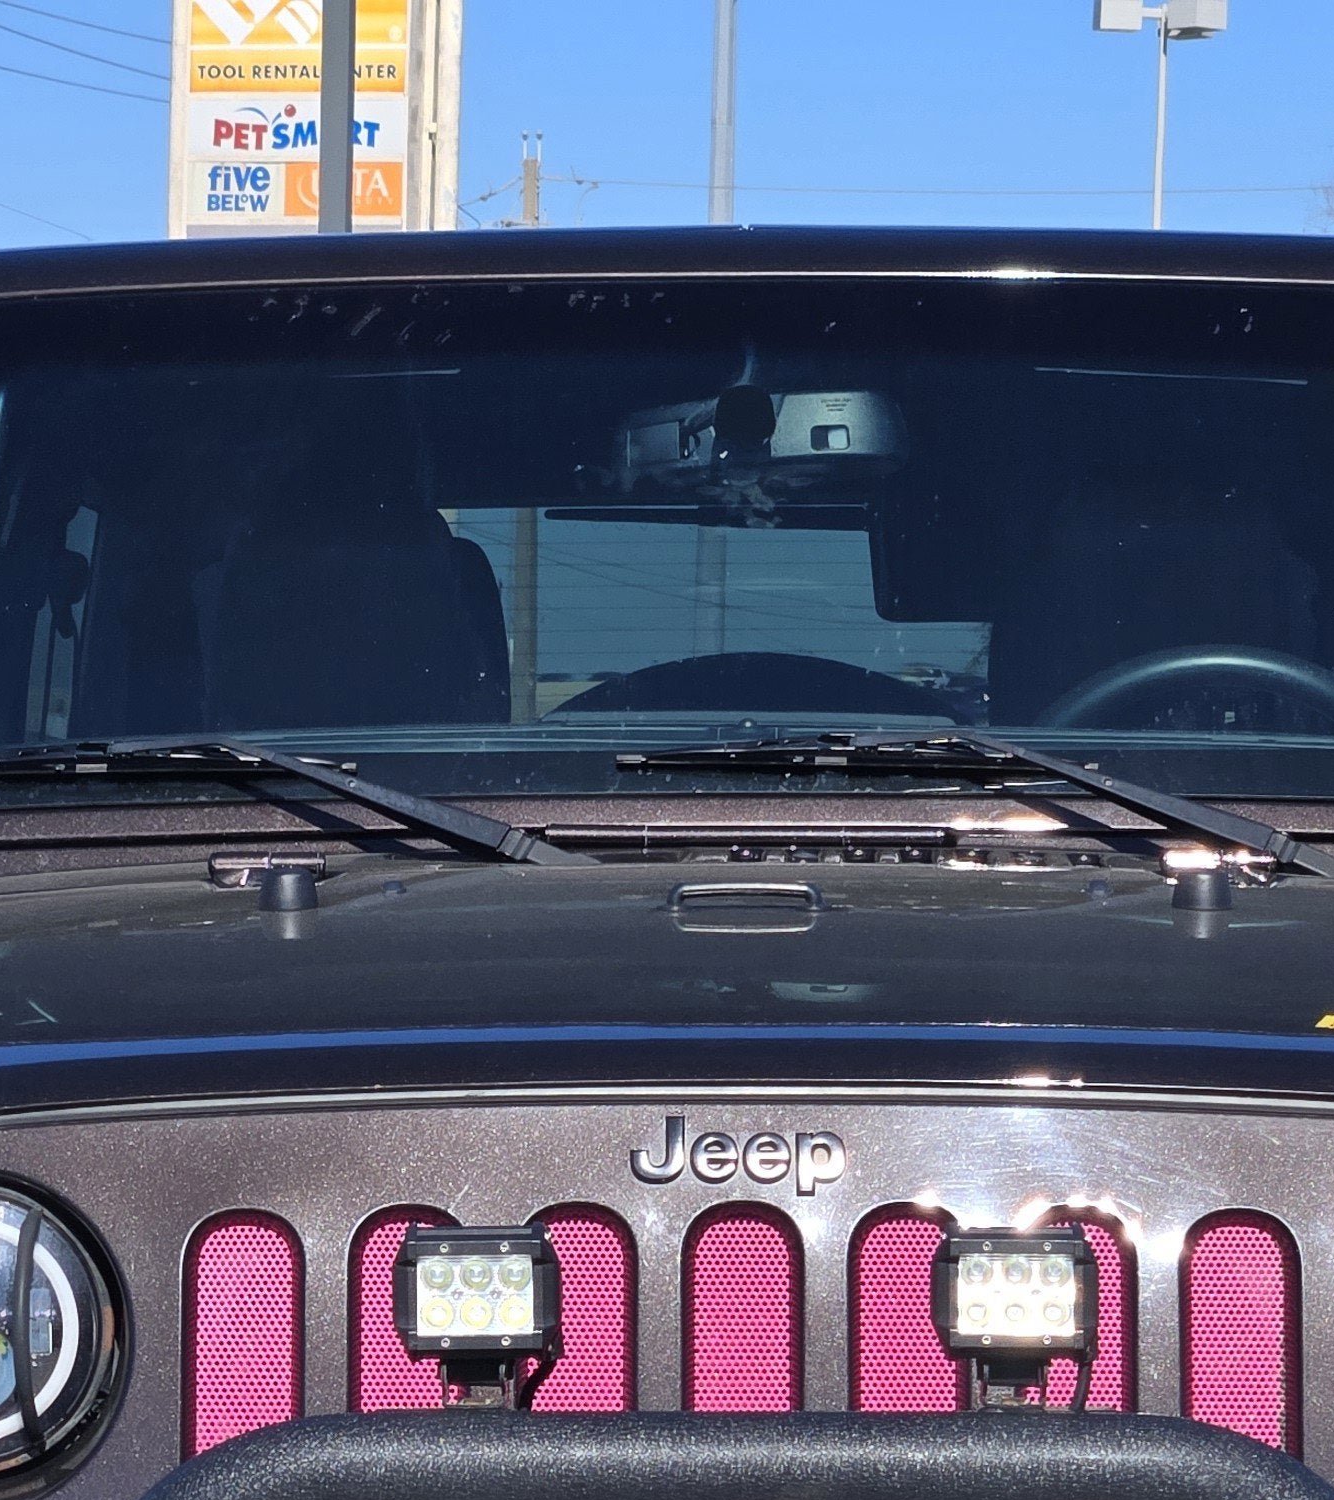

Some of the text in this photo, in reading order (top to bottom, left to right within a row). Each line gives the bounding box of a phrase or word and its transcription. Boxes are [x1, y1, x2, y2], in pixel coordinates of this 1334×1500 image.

[198, 64, 245, 79] TOOL
[252, 64, 321, 79] RENTAL
[212, 118, 381, 151] PETSMRT
[208, 165, 271, 192] five
[207, 194, 270, 212] BELOW
[630, 1115, 847, 1197] Jeep
